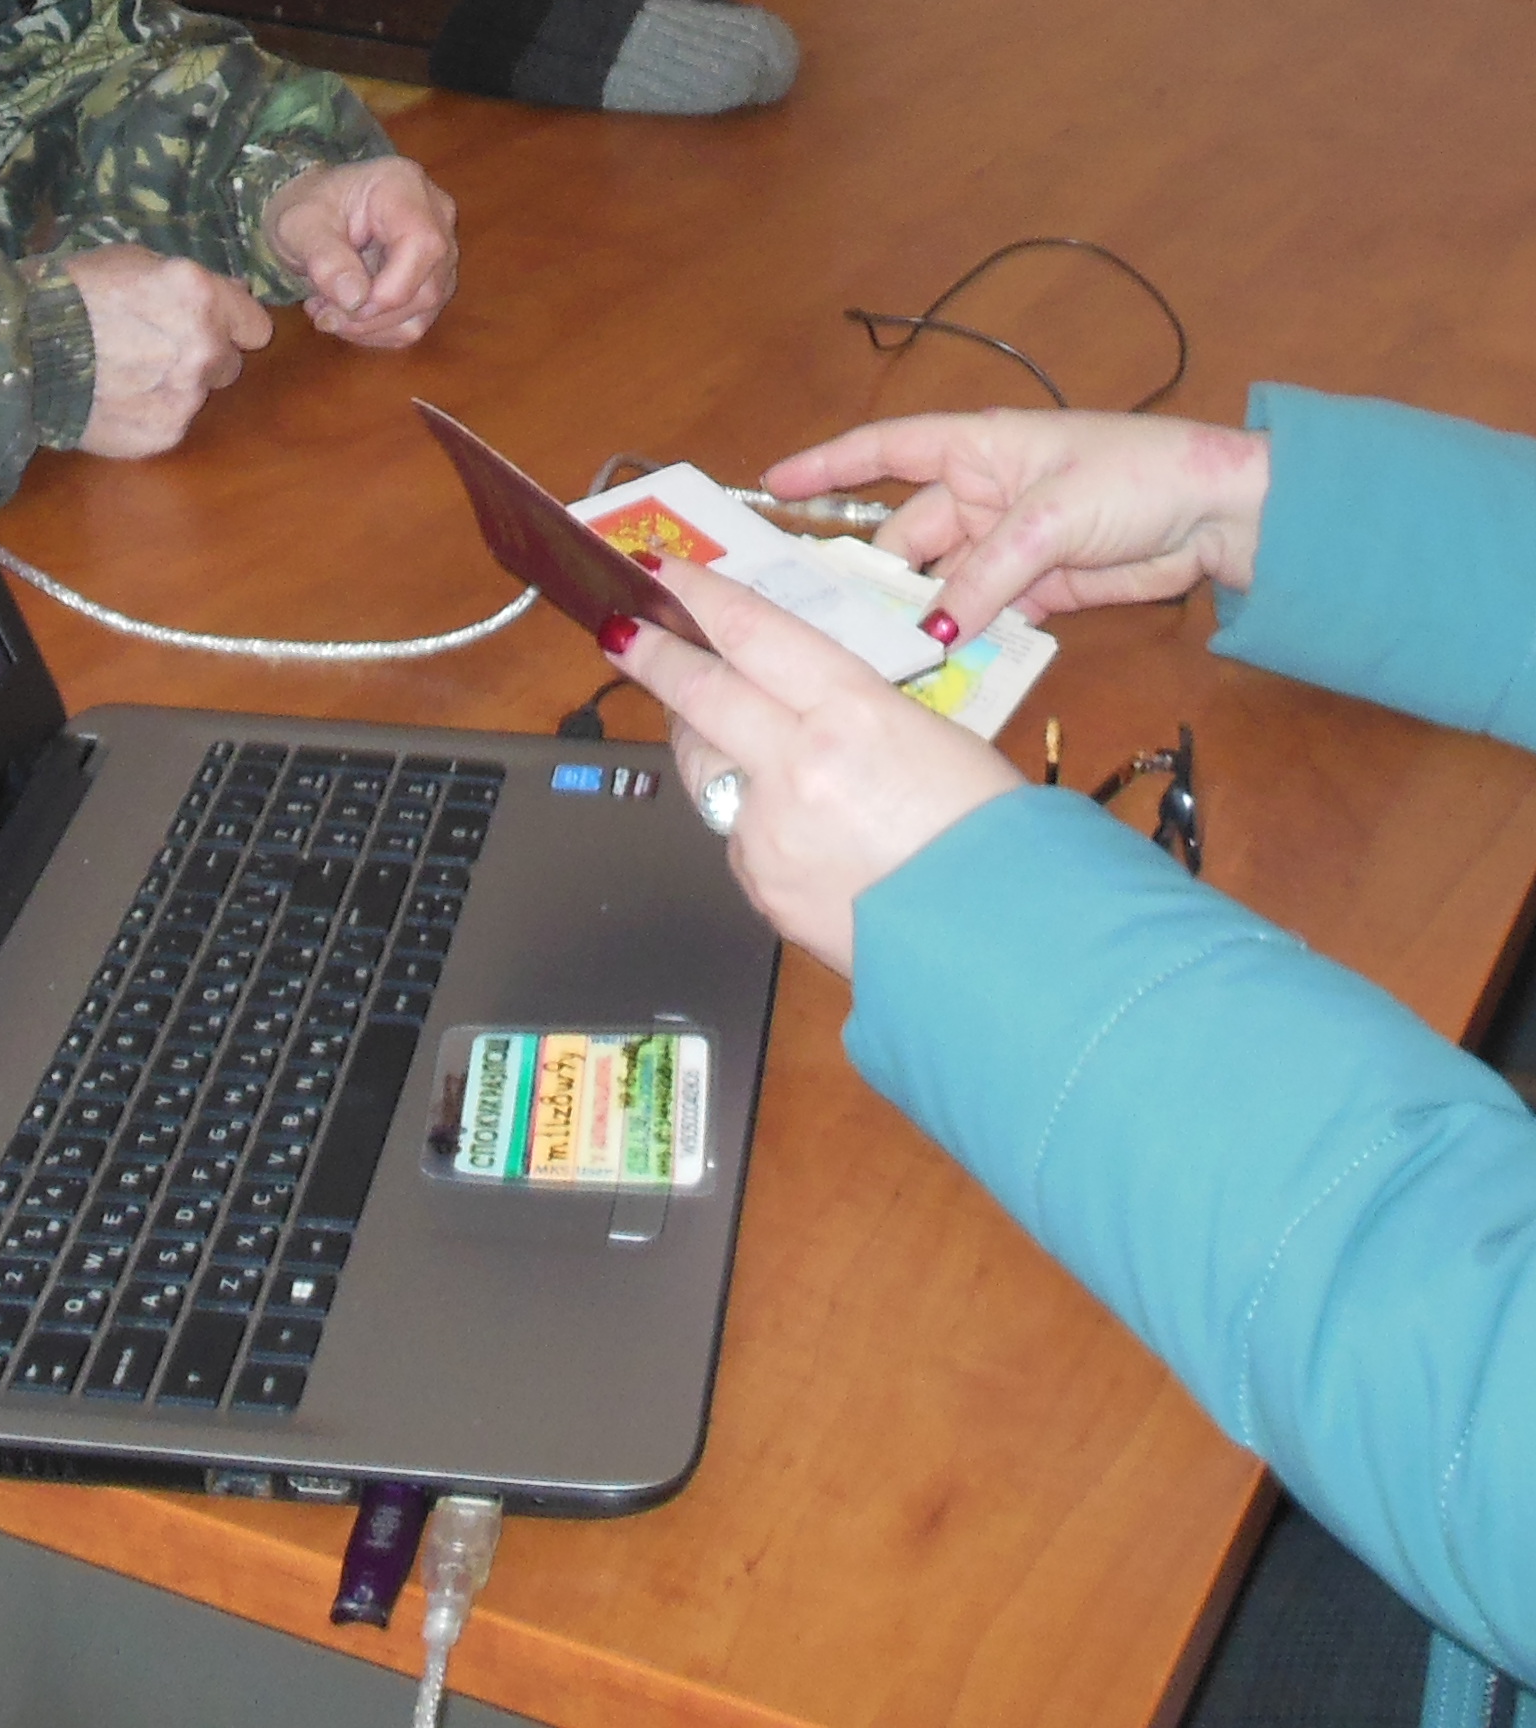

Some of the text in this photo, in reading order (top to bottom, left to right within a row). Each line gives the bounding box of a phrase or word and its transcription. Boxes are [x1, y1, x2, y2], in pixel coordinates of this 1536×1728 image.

[64, 1298, 85, 1313] Q
[82, 1252, 104, 1271] W
[102, 1212, 122, 1226] E
[120, 1171, 141, 1185] R
[137, 1131, 157, 1144] T
[154, 1094, 173, 1106] Y
[170, 1057, 189, 1070] U
[140, 1293, 161, 1308] A
[158, 1249, 178, 1263] S
[174, 1208, 196, 1222] D
[191, 1168, 209, 1181] F
[208, 1127, 228, 1141] G
[218, 1276, 240, 1293] Z
[235, 1233, 256, 1248] X
[251, 1192, 272, 1207] C
[266, 1152, 286, 1166] V
[281, 1113, 301, 1127] B
